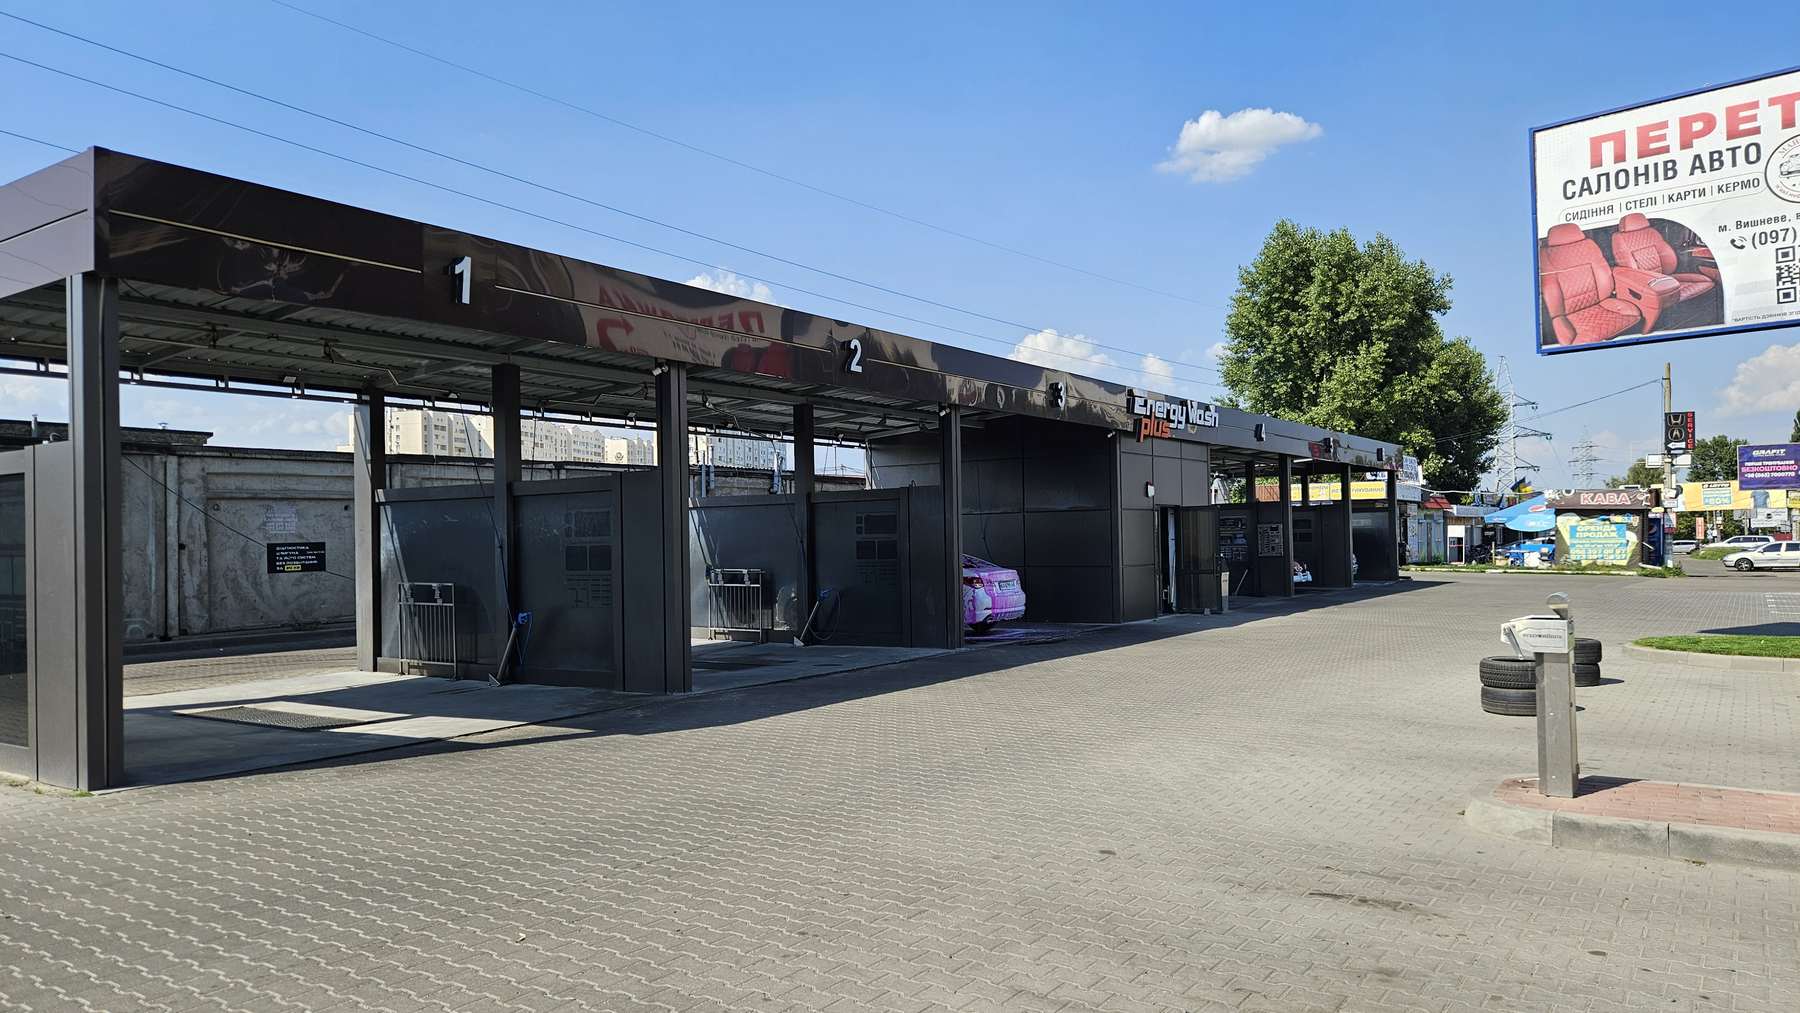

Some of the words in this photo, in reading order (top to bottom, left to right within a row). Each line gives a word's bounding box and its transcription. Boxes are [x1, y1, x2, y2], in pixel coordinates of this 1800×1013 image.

[1590, 91, 1800, 169] ПЕРЕТ
[1562, 159, 1678, 200] САЛОНІВ
[1689, 142, 1762, 176] АВТО
[1565, 204, 1614, 222] СИДІННЯ
[1625, 196, 1657, 211] СТЕЛІ
[1668, 188, 1706, 203] КАРТИ
[1717, 177, 1760, 194] КЕРМО
[1718, 224, 1731, 232] м.
[1751, 226, 1797, 249] (097)
[455, 256, 472, 304] 1
[850, 338, 863, 373] 2
[1134, 392, 1187, 430] Energy
[1187, 400, 1219, 428] Wash
[1140, 415, 1172, 443] plus
[1686, 412, 1694, 449] SERVICE
[1741, 465, 1798, 473] БЕЗКОШТОВНО
[1580, 493, 1631, 505] КАВА
